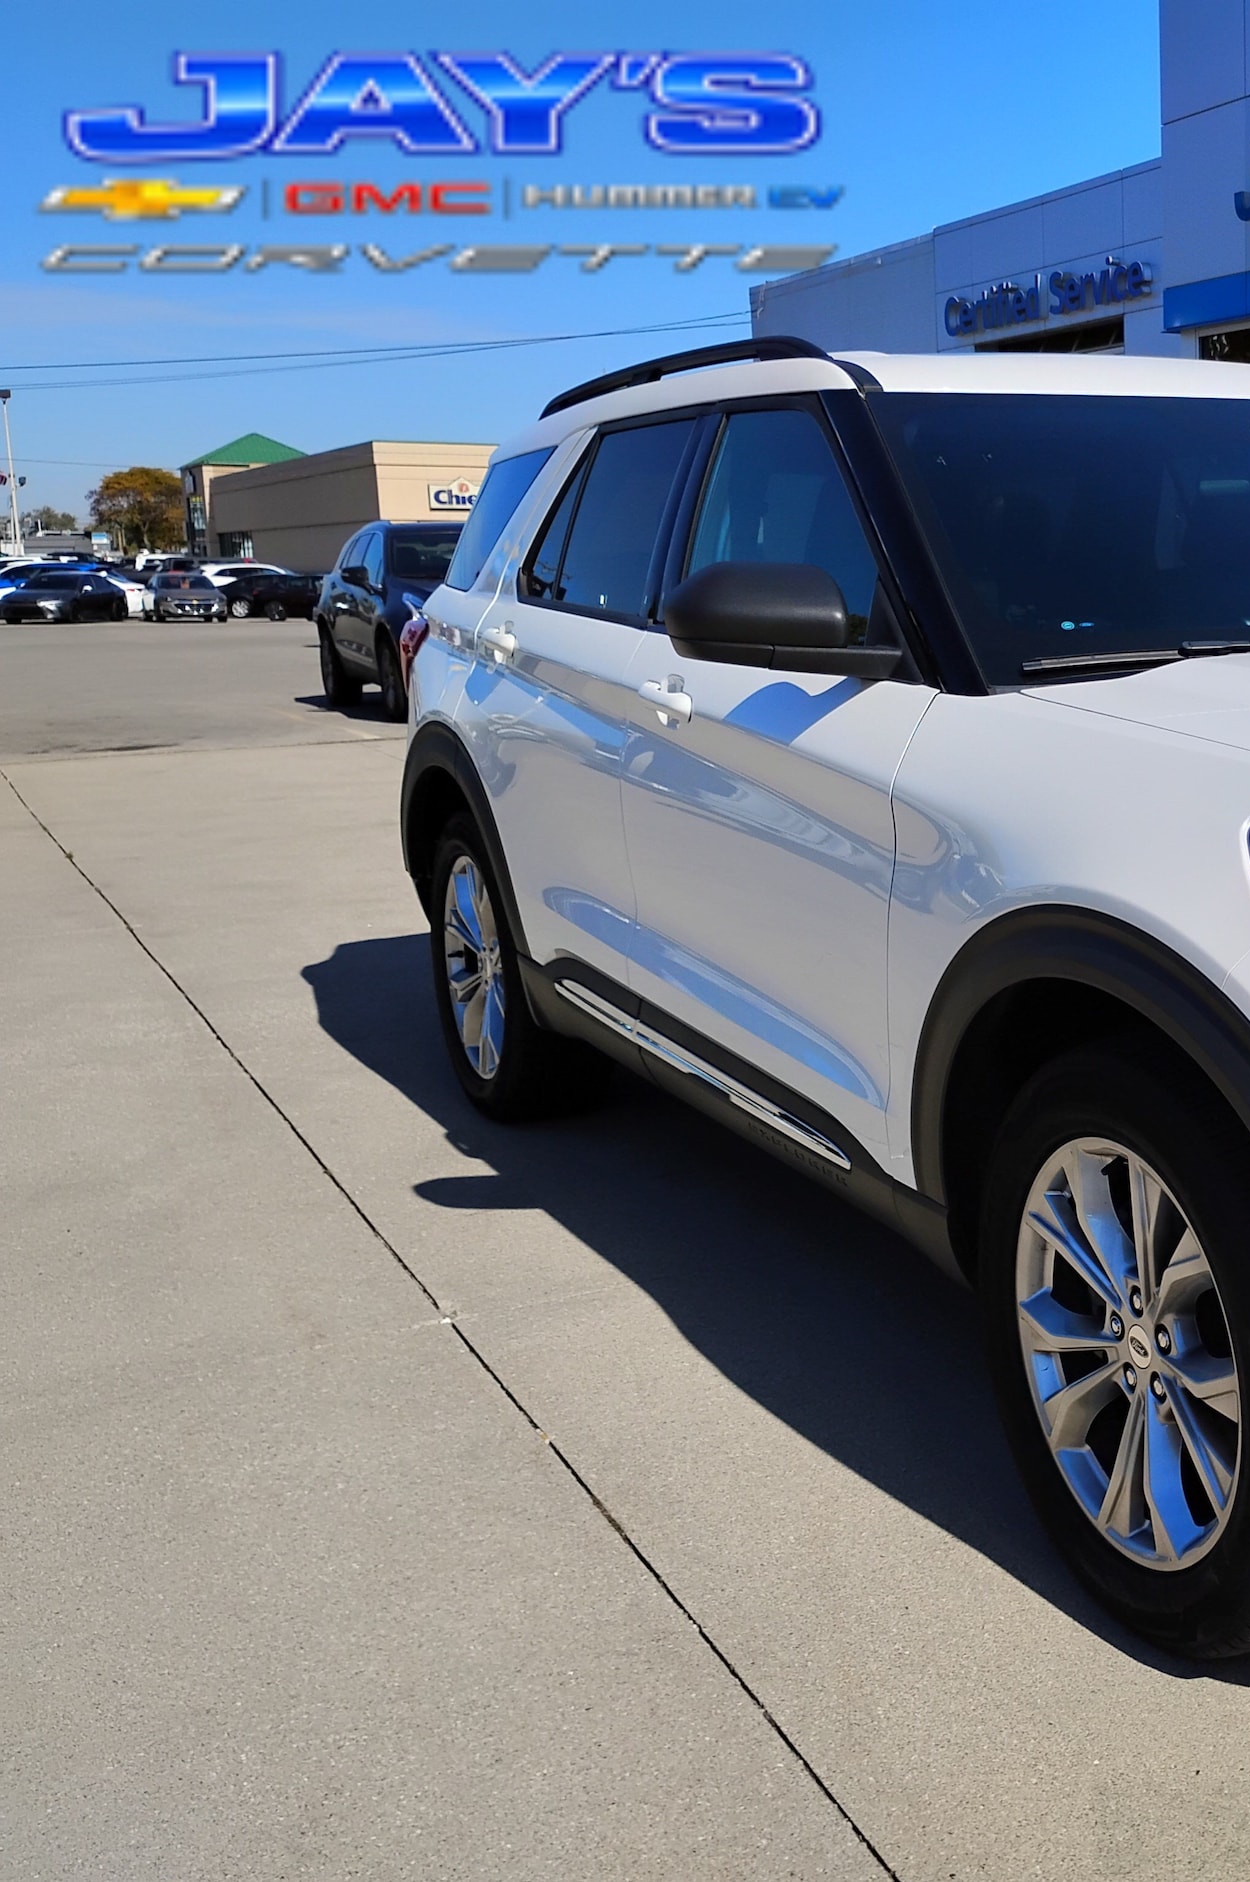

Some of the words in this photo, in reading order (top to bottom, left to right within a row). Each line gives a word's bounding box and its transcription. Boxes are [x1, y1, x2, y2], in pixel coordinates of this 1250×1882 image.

[944, 273, 1046, 337] Certified
[1049, 256, 1151, 315] Service
[433, 489, 478, 506] Chie
